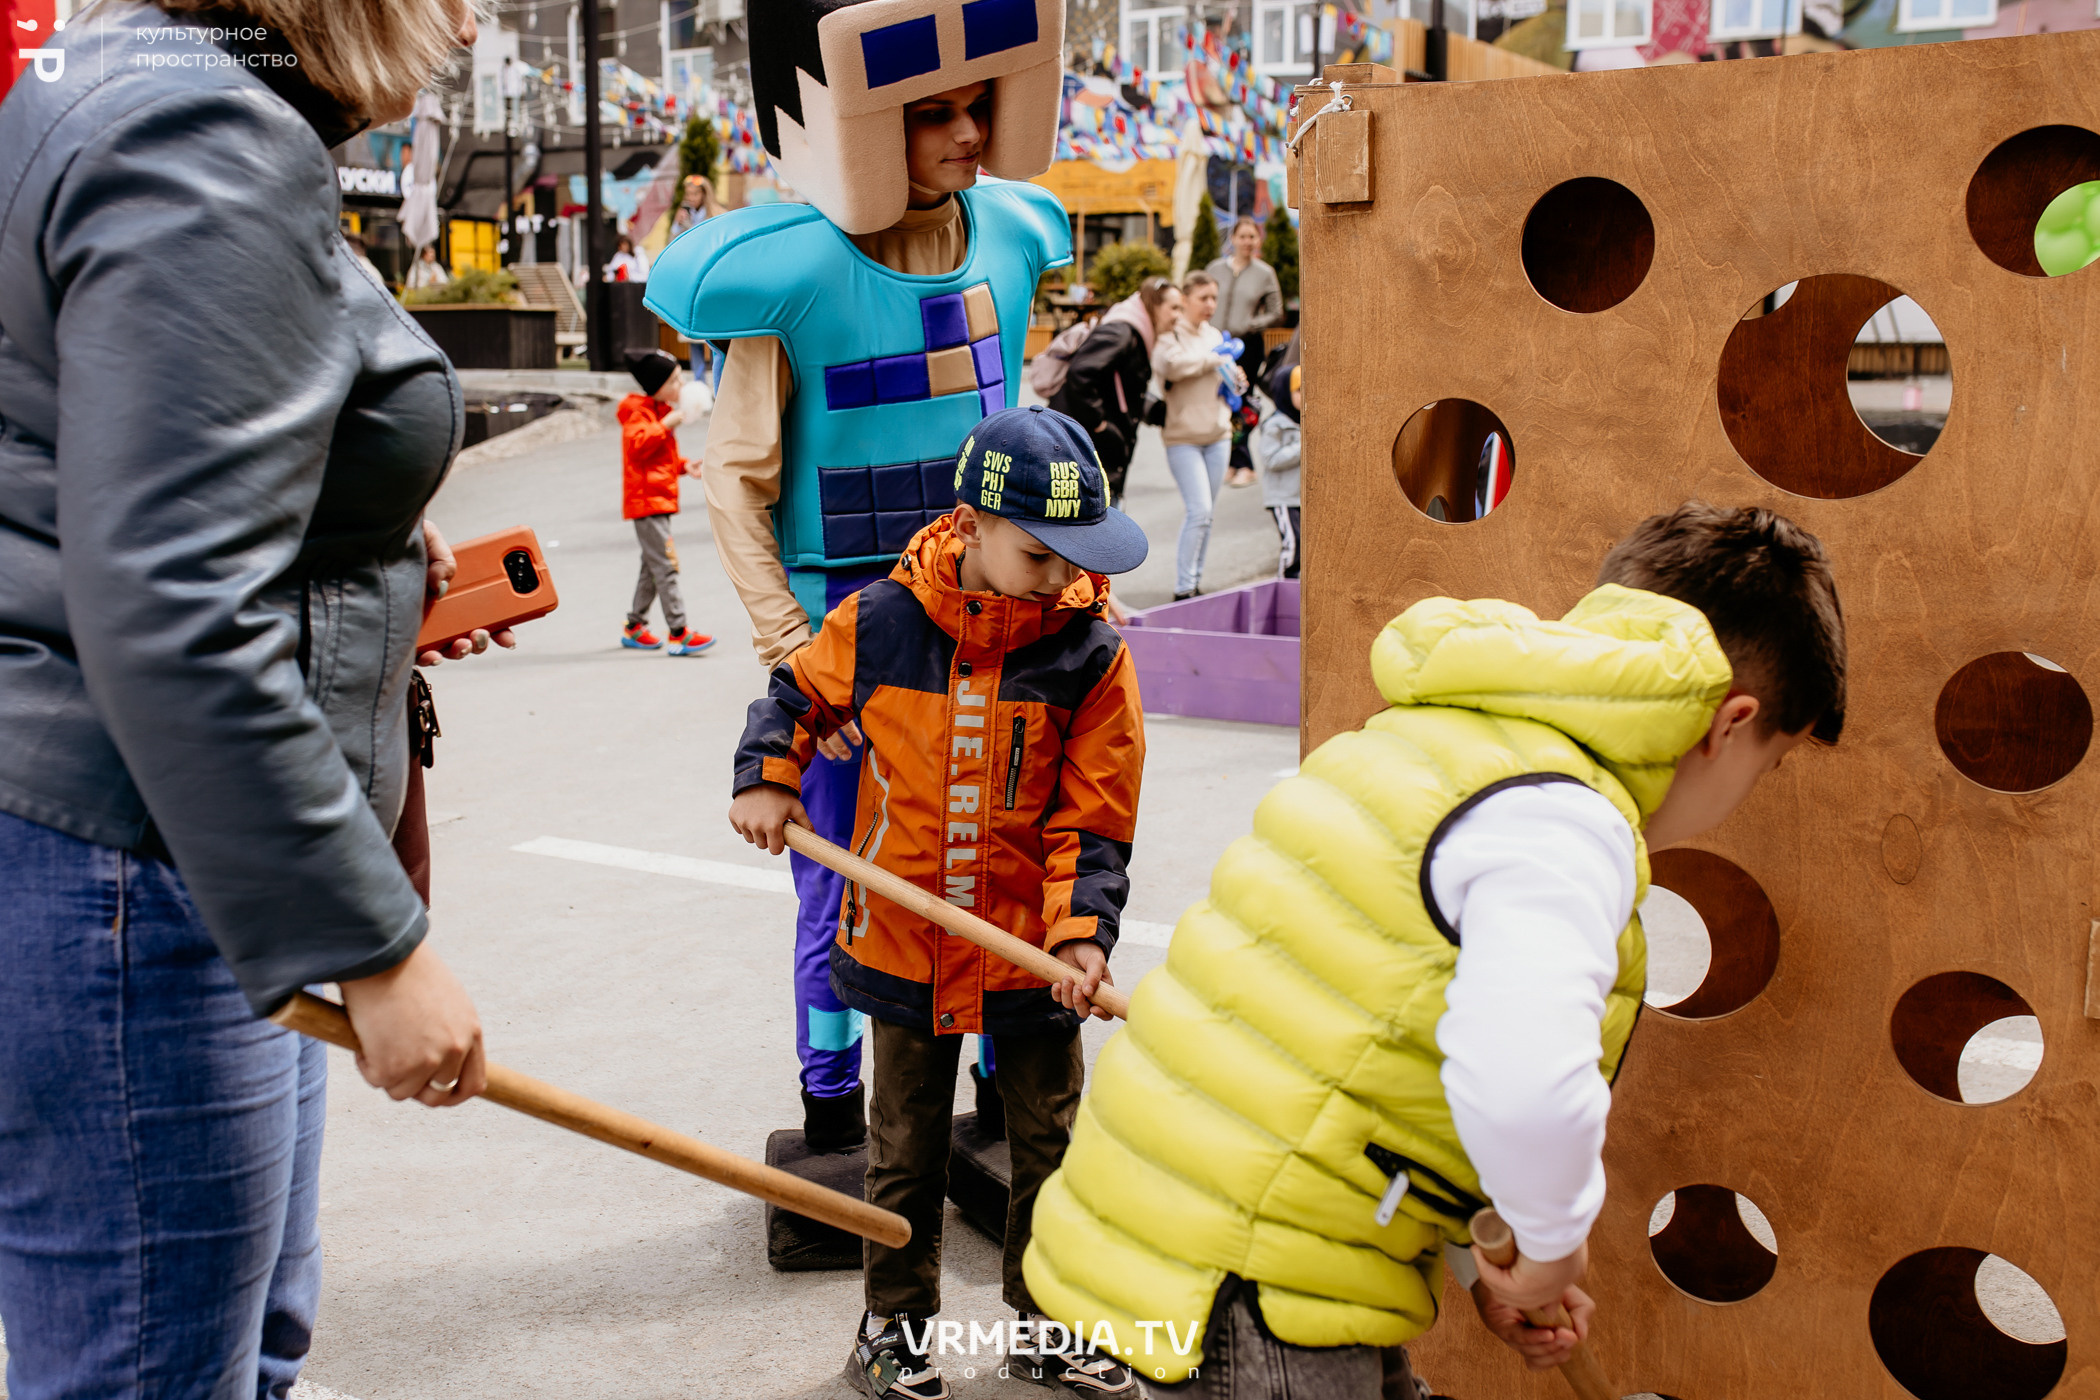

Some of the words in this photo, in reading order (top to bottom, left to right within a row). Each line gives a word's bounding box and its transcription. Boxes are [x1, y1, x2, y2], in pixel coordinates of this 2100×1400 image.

[983, 450, 1012, 473] SWS
[1049, 461, 1080, 480] RUS
[1051, 479, 1079, 499] GBR
[980, 489, 1002, 511] GER
[1044, 498, 1081, 518] NWY
[944, 680, 986, 936] JIE.RELM
